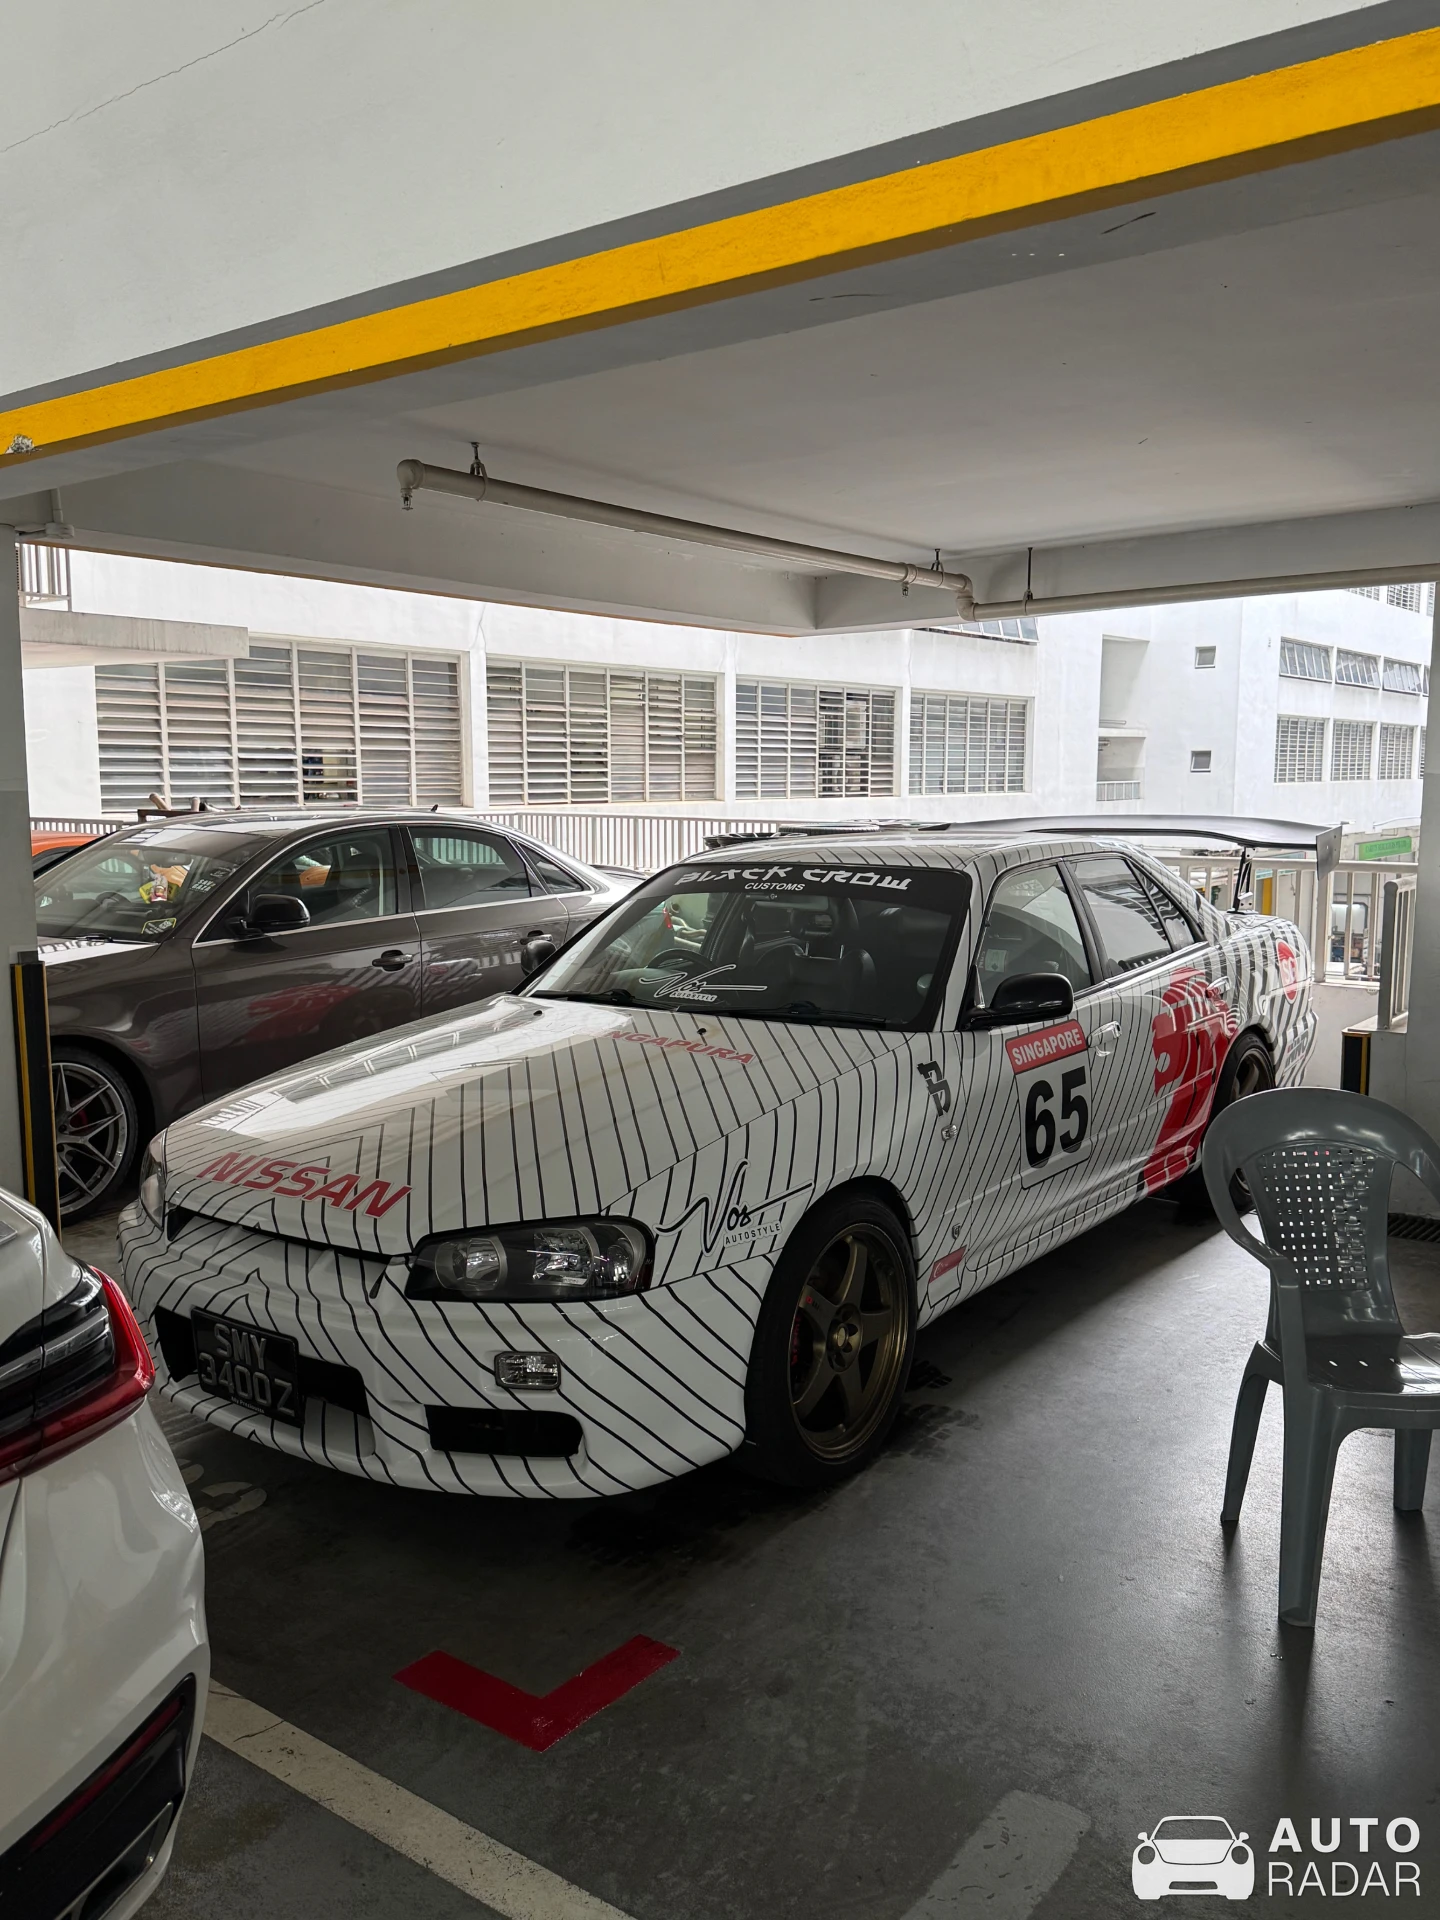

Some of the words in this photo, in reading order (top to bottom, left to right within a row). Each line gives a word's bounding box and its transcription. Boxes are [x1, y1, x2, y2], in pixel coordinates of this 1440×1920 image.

[674, 866, 793, 886] BLACK
[802, 868, 913, 891] CROW
[744, 882, 806, 891] CUSTOMS
[592, 1030, 756, 1064] NGAPURA
[1012, 1028, 1083, 1066] SINGAPORE
[1025, 1065, 1089, 1169] 65
[196, 1151, 413, 1218] NISSAN
[725, 1223, 781, 1245] AUTOSTYLE
[214, 1323, 267, 1370] SMY
[199, 1352, 296, 1417] 3400Z
